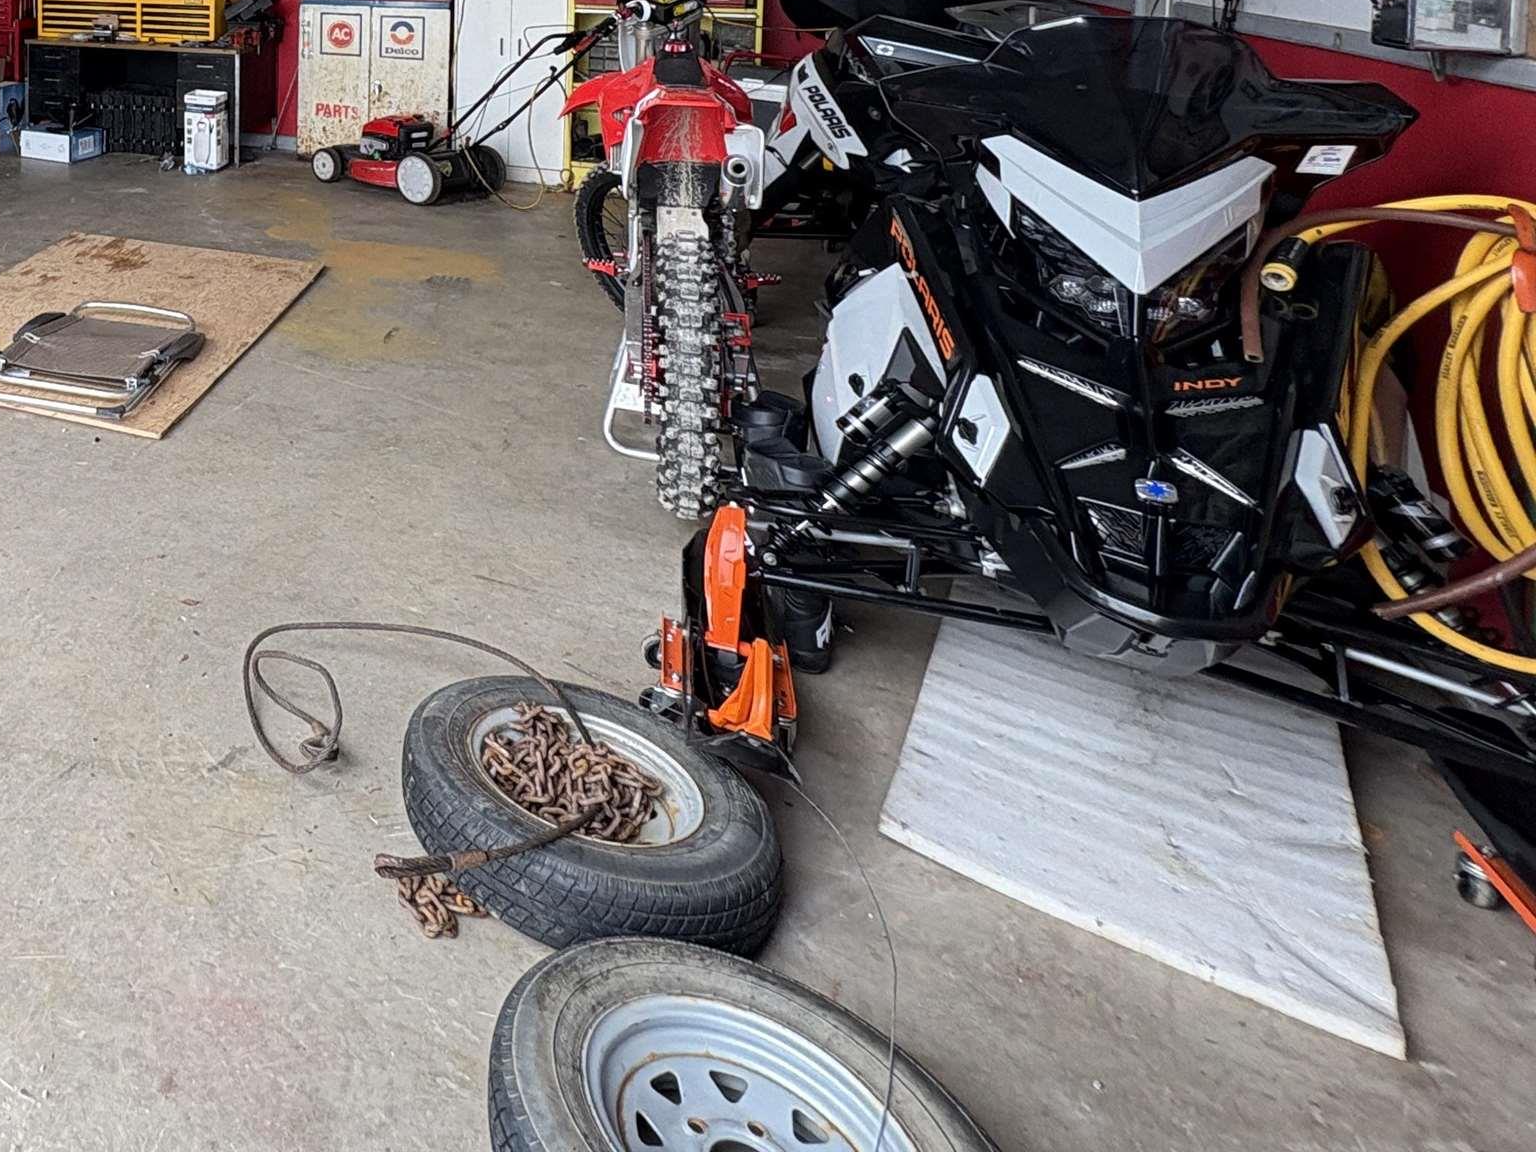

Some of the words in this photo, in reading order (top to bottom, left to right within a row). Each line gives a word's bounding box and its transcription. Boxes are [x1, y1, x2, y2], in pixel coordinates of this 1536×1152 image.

[331, 28, 351, 41] AC
[384, 46, 420, 56] Delco
[315, 102, 361, 120] PARTS
[801, 85, 853, 140] POLARIS
[890, 217, 956, 361] POLARIS
[1173, 377, 1243, 392] INDY
